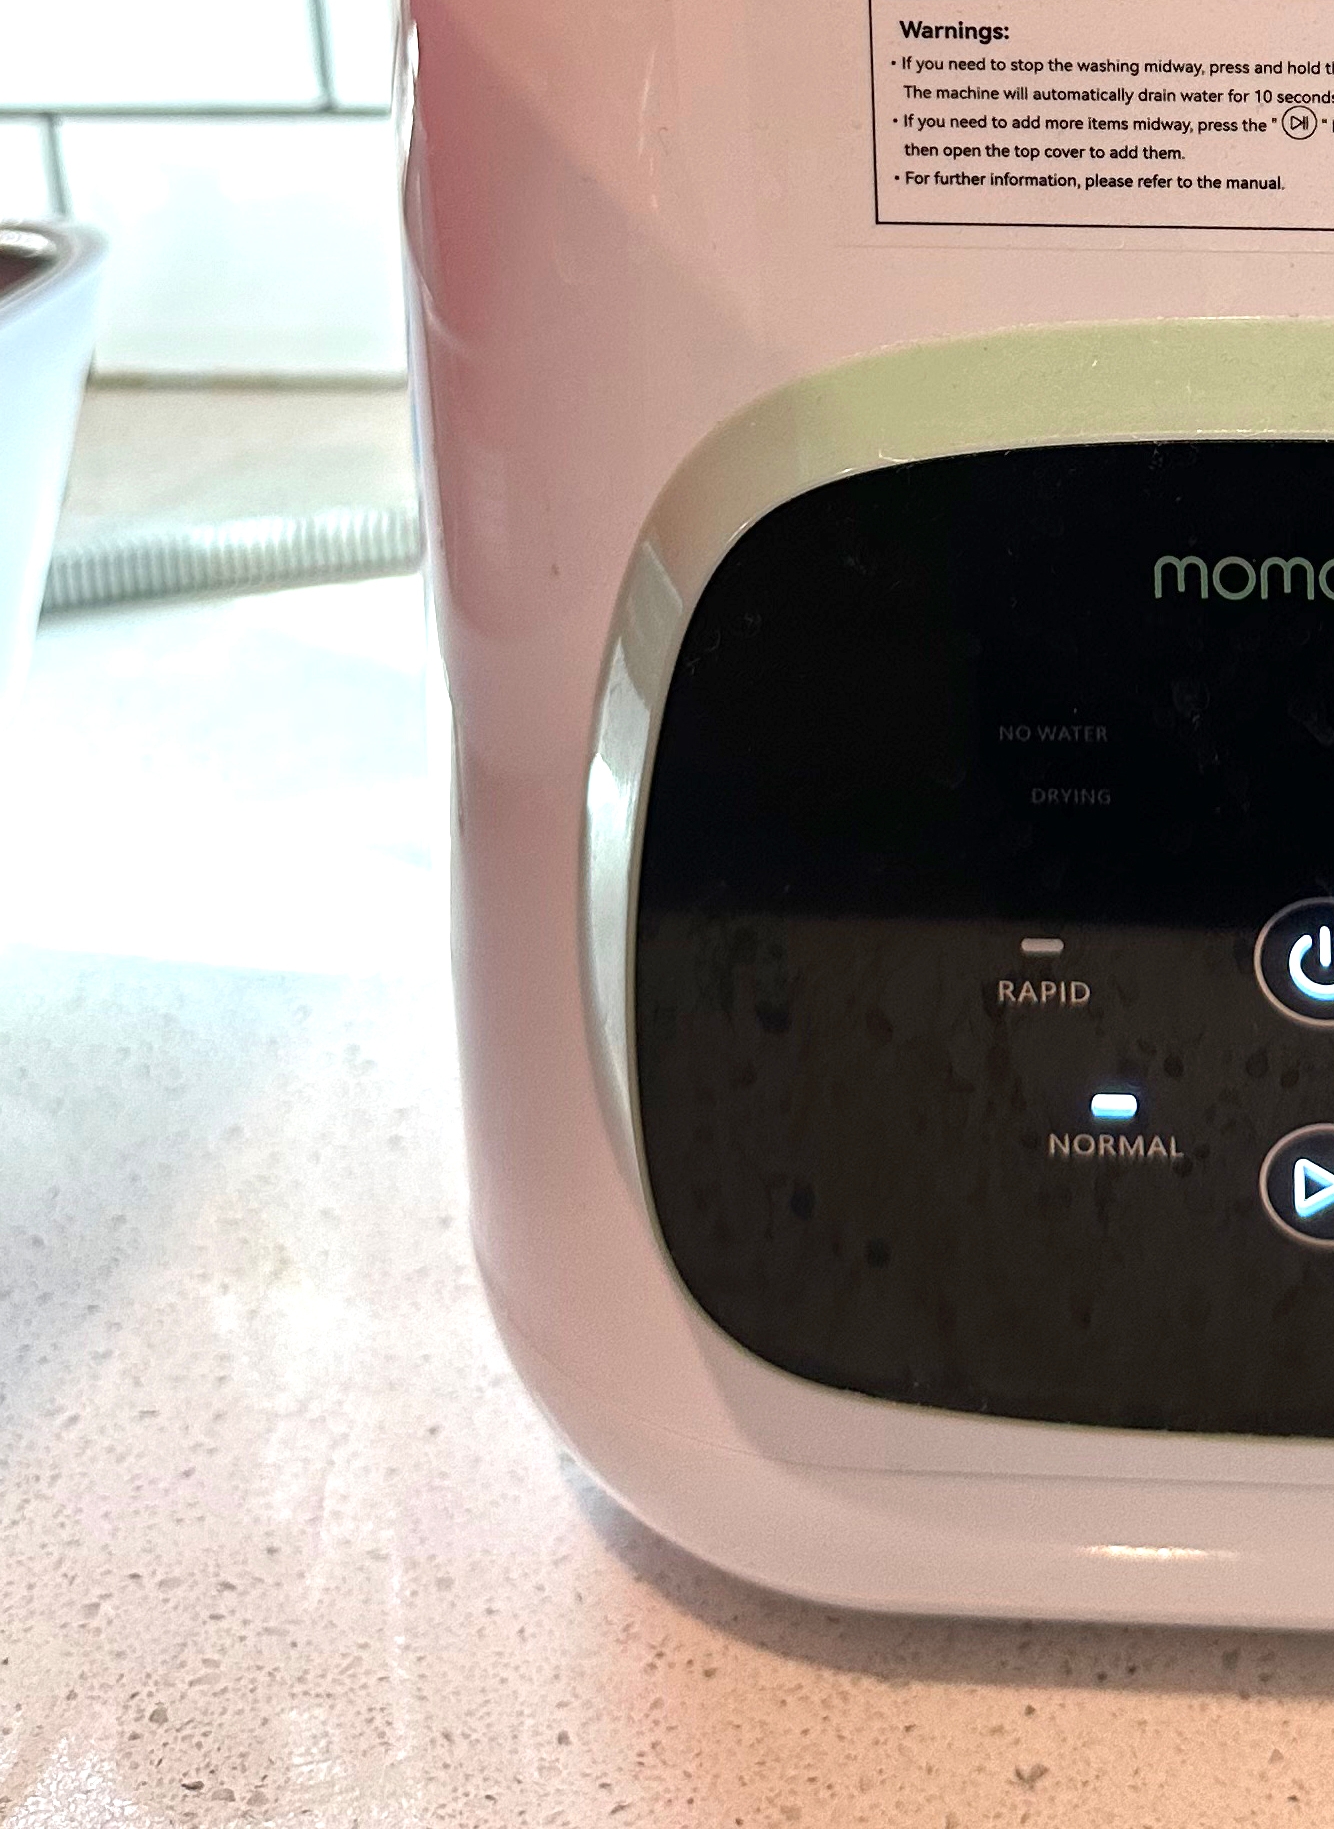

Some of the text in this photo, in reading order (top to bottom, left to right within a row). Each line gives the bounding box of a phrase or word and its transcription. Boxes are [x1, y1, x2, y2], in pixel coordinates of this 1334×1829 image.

[899, 20, 1009, 45] Warnings:
[902, 56, 912, 69] If
[916, 60, 943, 74] you
[949, 57, 985, 71] need
[990, 59, 1006, 71] to
[1011, 59, 1044, 75] stop
[1047, 58, 1073, 72] the
[1077, 59, 1139, 76] washing
[1145, 59, 1205, 77] midway,
[1210, 63, 1250, 77] press
[1254, 61, 1282, 74] and
[1288, 61, 1320, 75] hold
[903, 85, 932, 99] The
[936, 85, 999, 100] machine
[1003, 87, 1028, 100] will
[1033, 87, 1134, 105] automatically
[1138, 88, 1176, 102] drain
[1180, 90, 1224, 102] water
[1228, 89, 1250, 103] for
[1255, 90, 1272, 105] 10
[904, 113, 914, 127] If
[917, 117, 945, 132] you
[950, 115, 987, 128] need
[992, 116, 1007, 128] to
[1012, 115, 1040, 129] add
[1045, 119, 1083, 130] more
[1088, 117, 1128, 130] items
[1133, 117, 1193, 134] midway,
[1198, 121, 1238, 135] press
[1242, 118, 1267, 132] the
[904, 142, 1185, 161] then open the top cover to add them.
[905, 171, 1285, 191] For further information, please refer to the manual.
[1000, 725, 1109, 743] NO WATER
[1031, 788, 1112, 806] DRYING
[998, 980, 1092, 1006] RAPID
[1049, 1133, 1184, 1160] NORMAL
